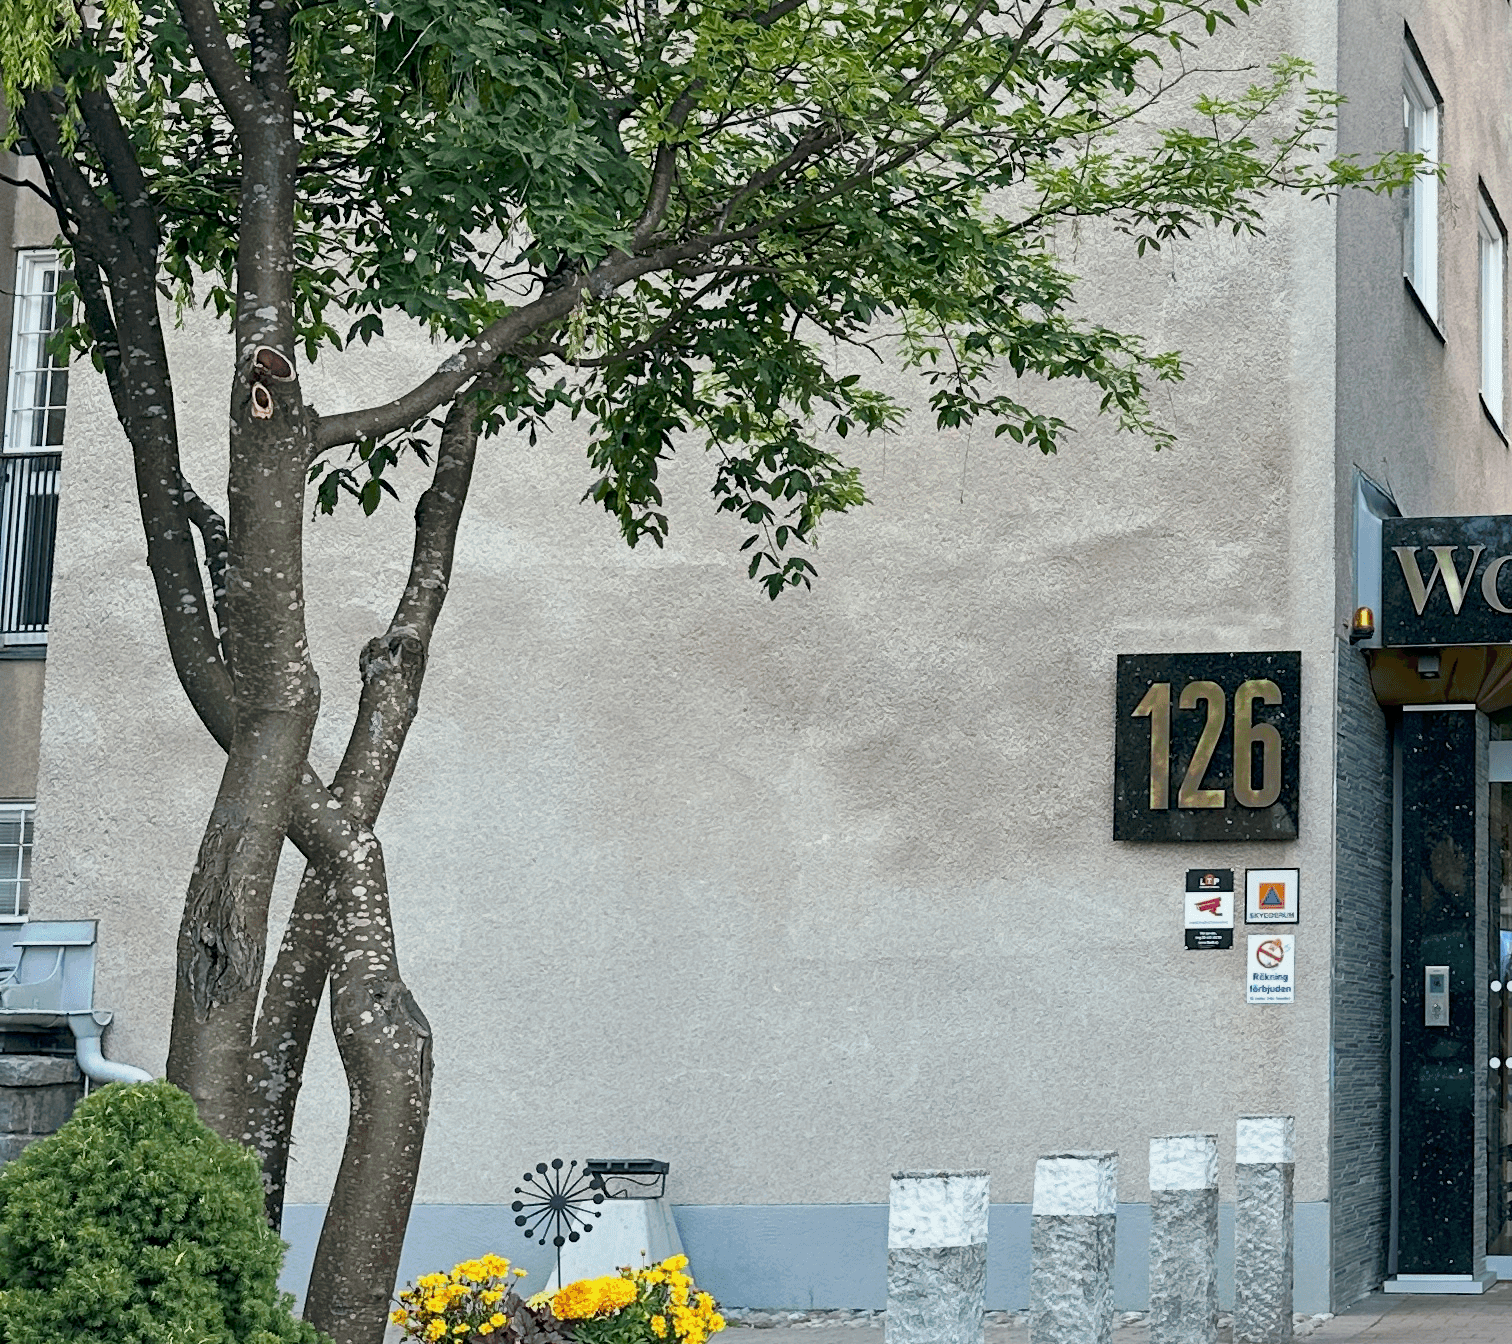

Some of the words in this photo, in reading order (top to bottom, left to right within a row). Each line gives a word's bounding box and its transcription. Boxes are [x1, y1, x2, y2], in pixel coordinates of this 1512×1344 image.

[1130, 678, 1283, 810] 126
[1252, 972, 1289, 982] Rökning
[1249, 984, 1292, 994] förbjuden
